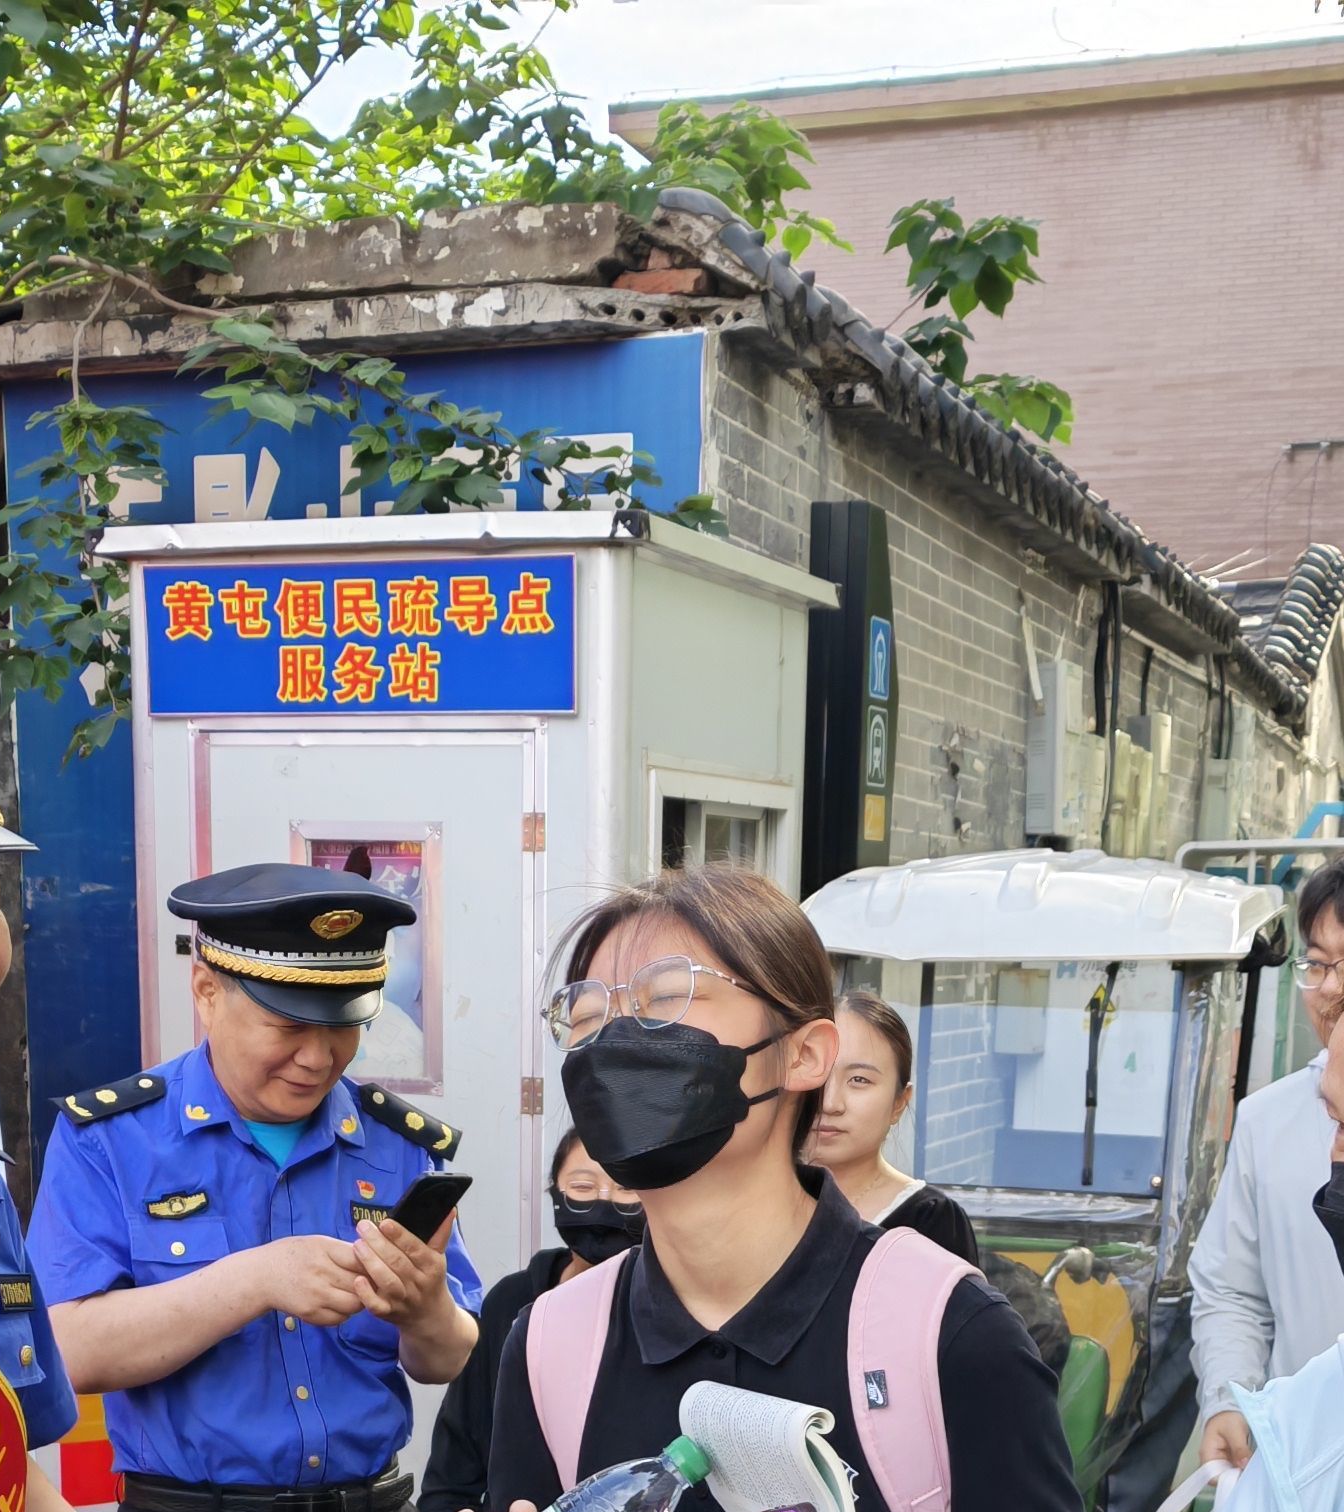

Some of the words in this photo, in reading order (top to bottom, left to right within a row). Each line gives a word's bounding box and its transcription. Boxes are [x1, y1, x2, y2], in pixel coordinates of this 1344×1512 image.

[163, 573, 554, 641] 黄屯便民疏导点
[277, 643, 440, 703] 服务站
